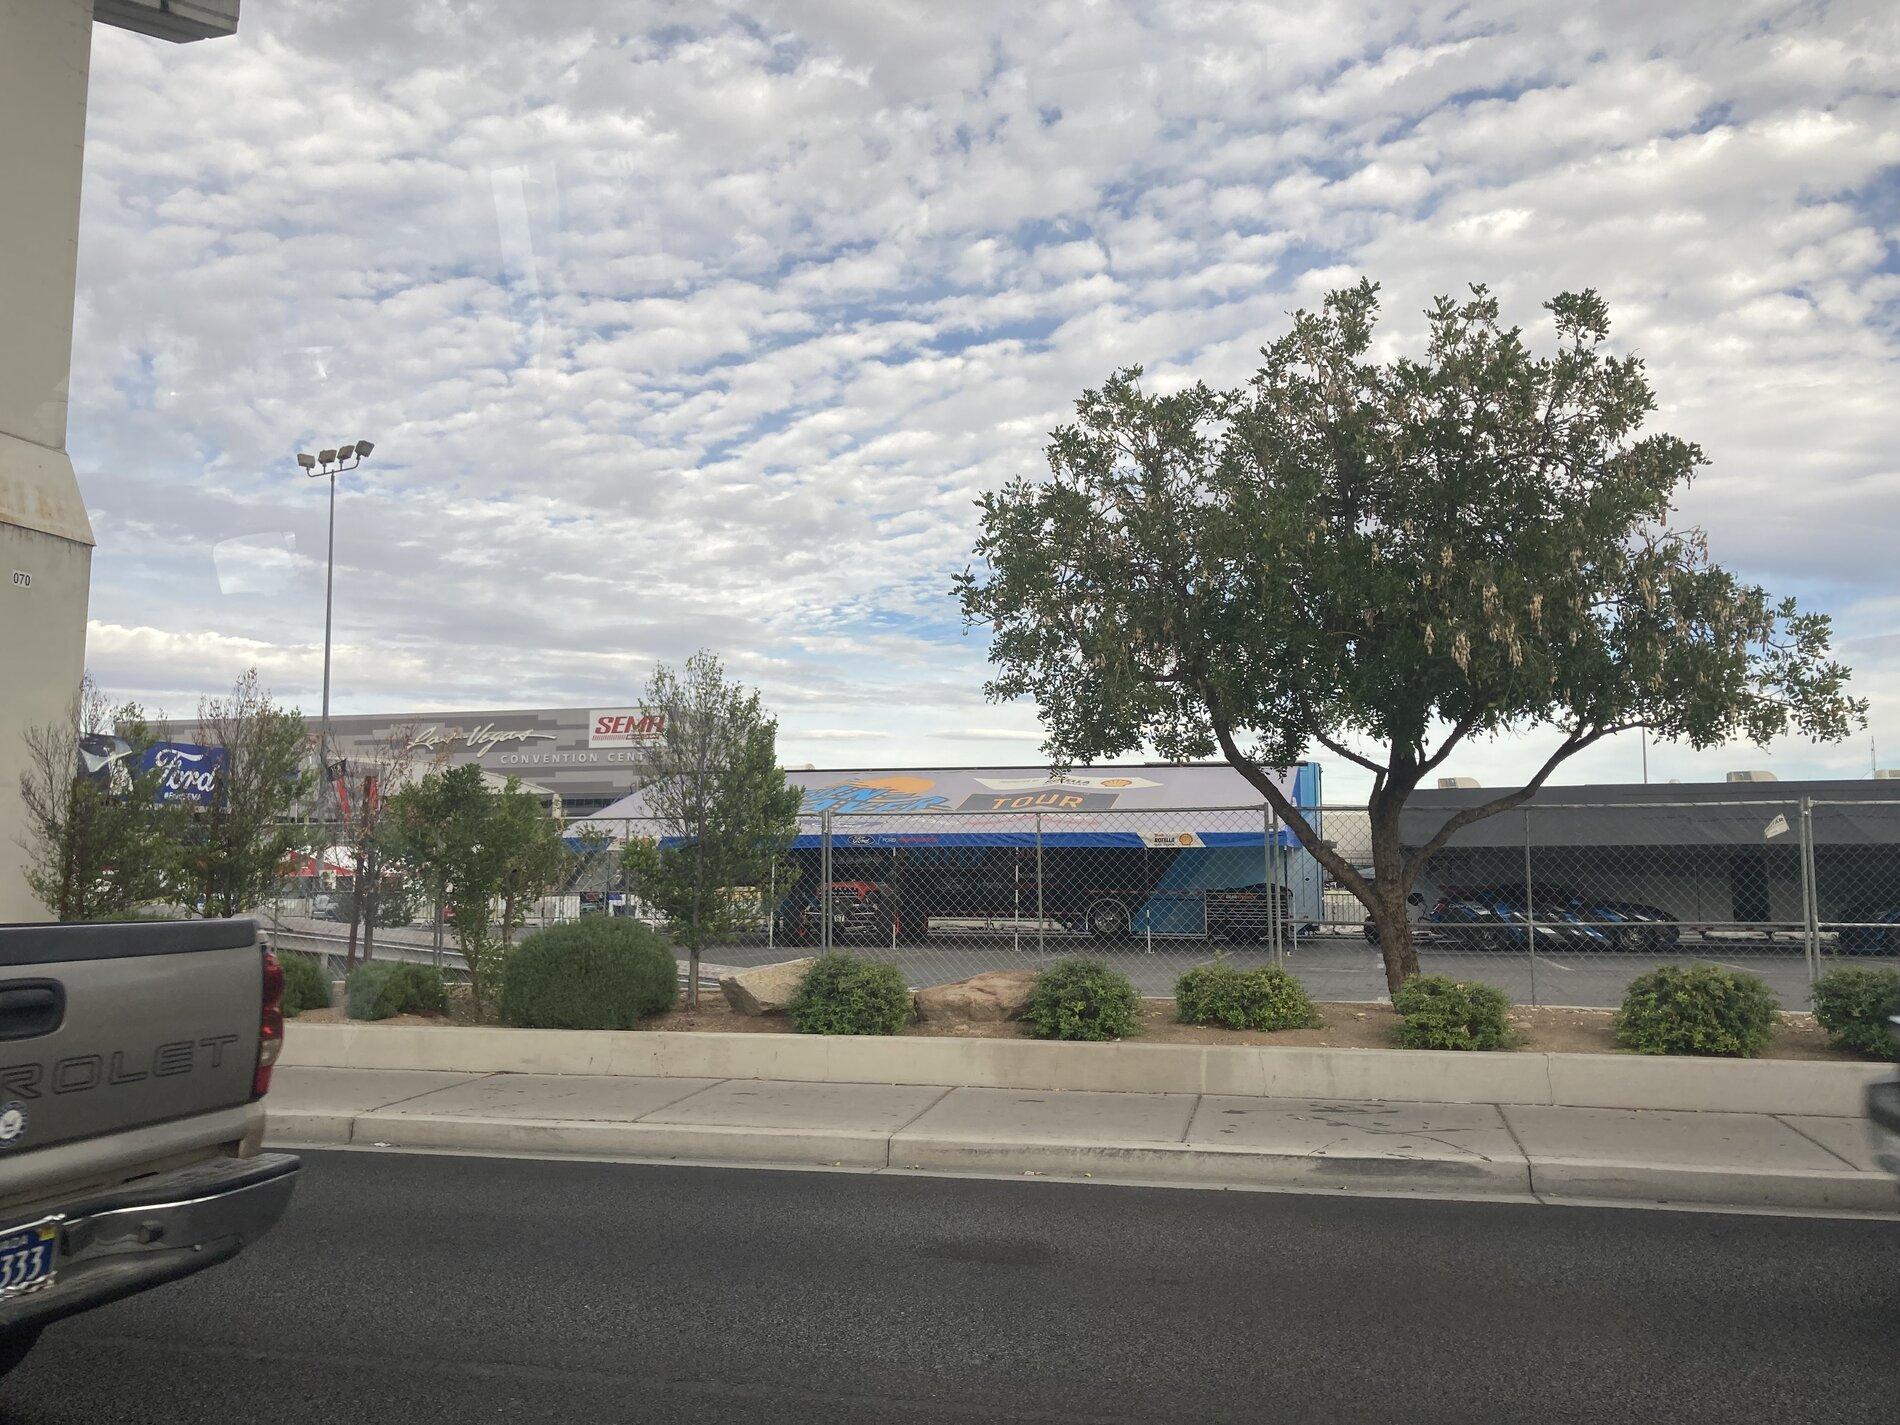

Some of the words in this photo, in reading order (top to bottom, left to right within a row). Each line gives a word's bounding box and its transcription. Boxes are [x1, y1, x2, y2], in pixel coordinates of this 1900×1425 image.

[13, 572, 31, 586] 070
[465, 722, 557, 758] Vegas
[500, 753, 598, 765] CONVENTION
[607, 752, 646, 763] CENT
[155, 749, 221, 792] Ford
[991, 793, 1084, 811] TOUR
